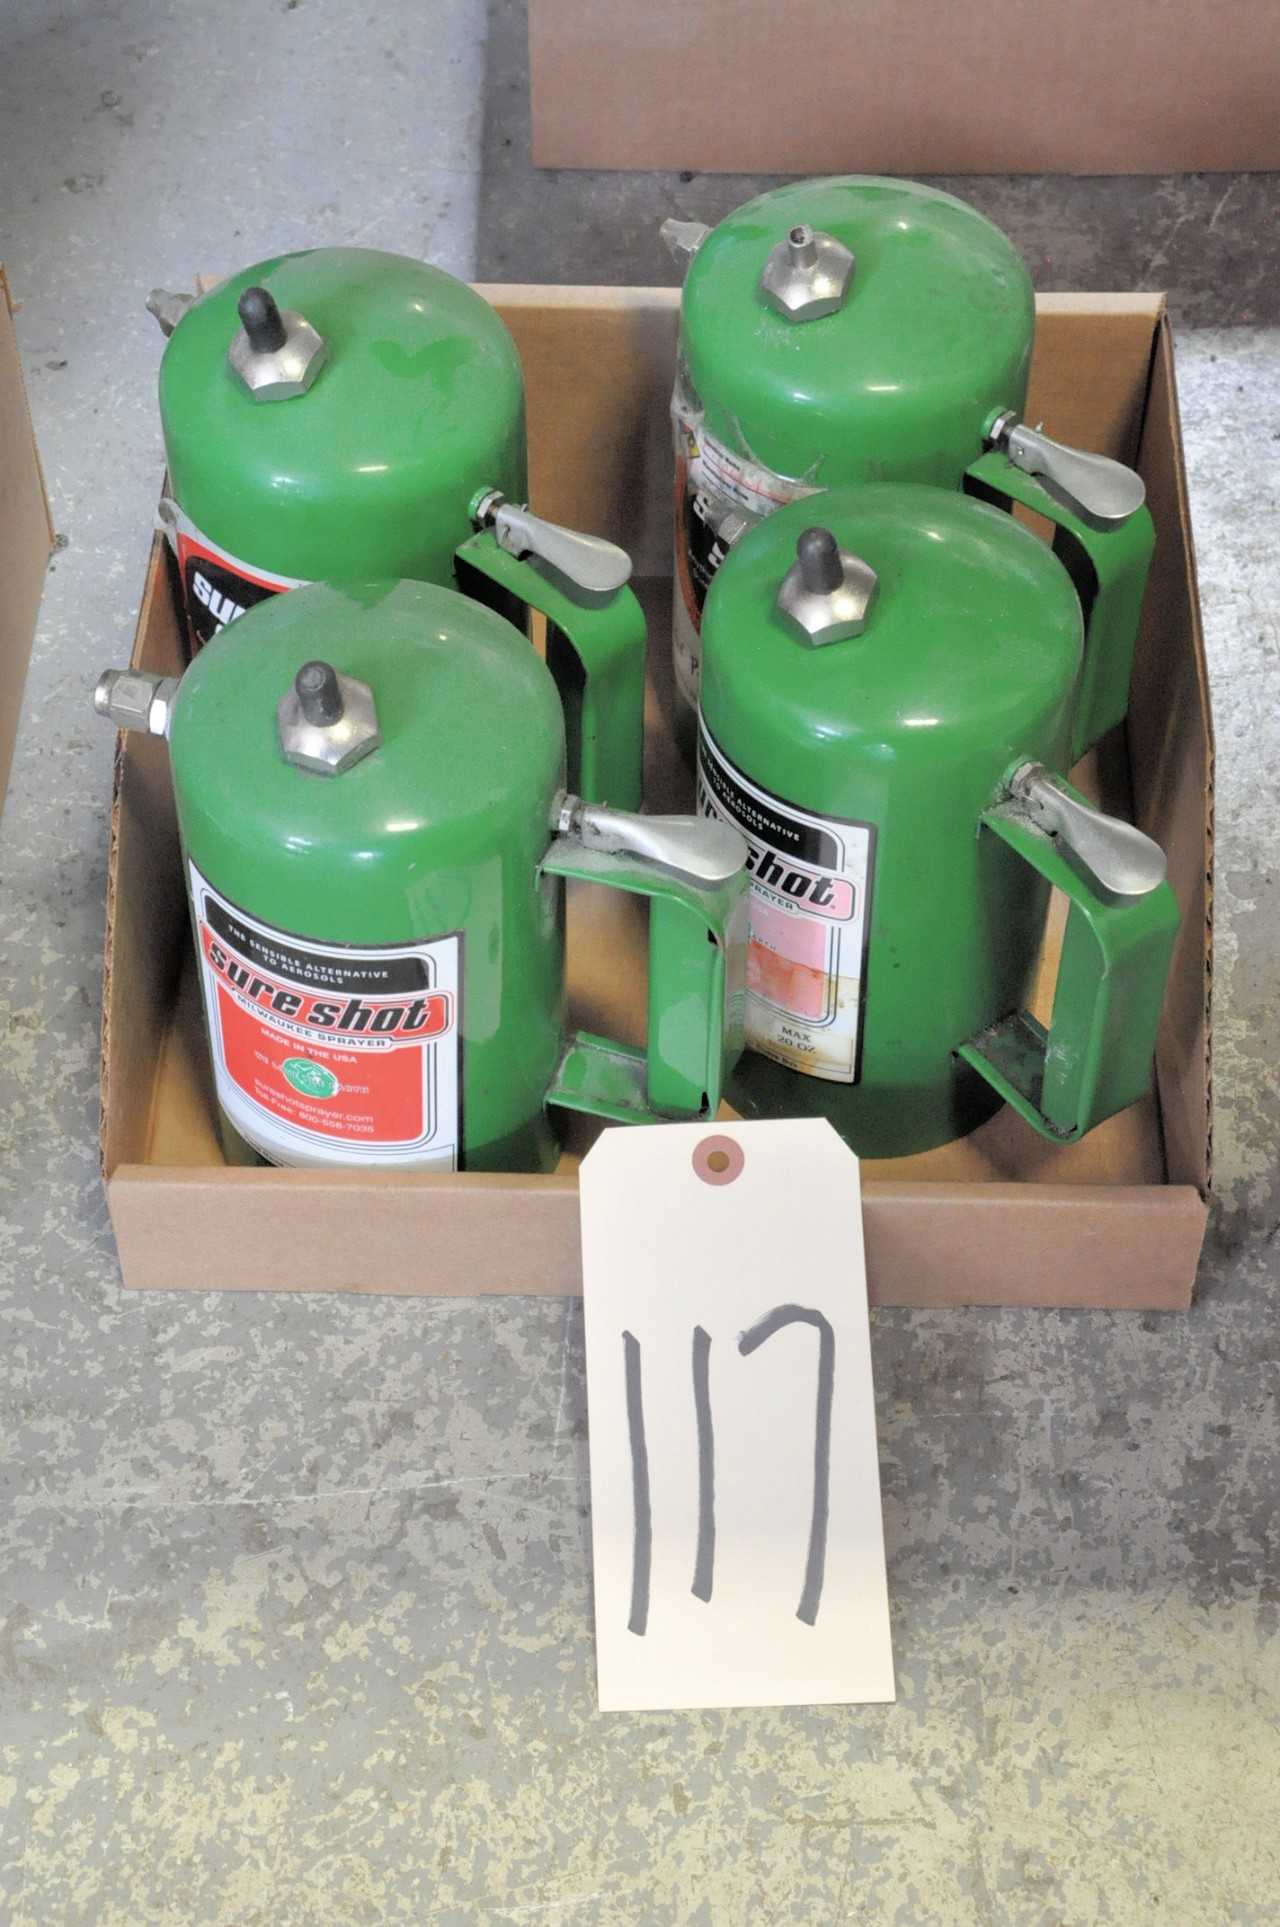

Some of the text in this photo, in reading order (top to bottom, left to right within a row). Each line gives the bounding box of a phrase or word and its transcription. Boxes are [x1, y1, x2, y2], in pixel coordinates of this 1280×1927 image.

[737, 798, 800, 842] ALTERNATIVE
[228, 924, 389, 979] THE SENSIBLE ALTERNATIVE
[263, 954, 344, 984] TO AEROSOLS
[209, 942, 432, 1032] sure shot
[237, 994, 386, 1047] MILWAUKEE SPRAYER
[782, 1026, 810, 1042] MAX
[260, 1028, 358, 1064] MADE IN THE USA
[622, 1304, 835, 1636] 117
